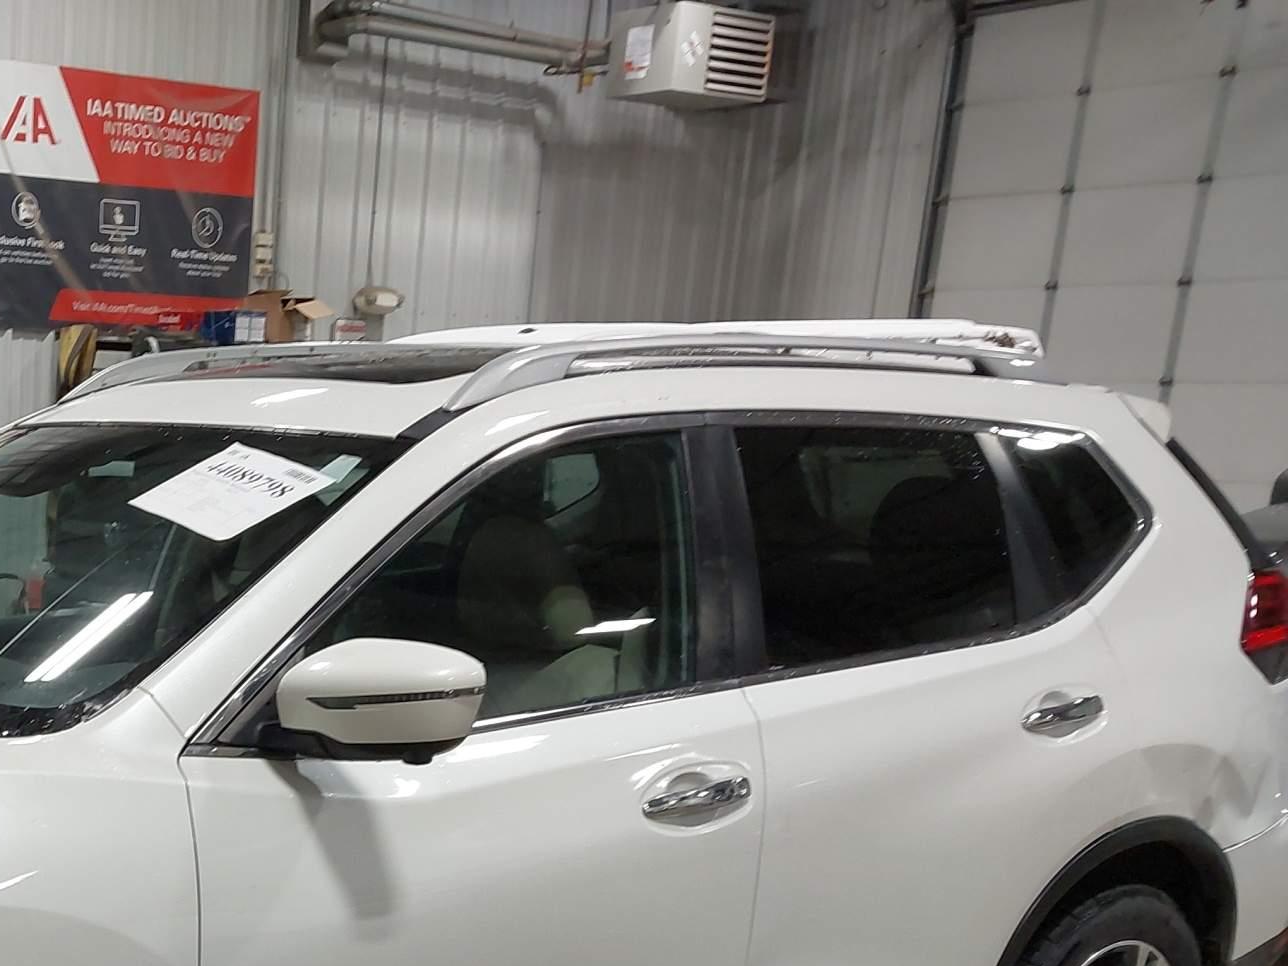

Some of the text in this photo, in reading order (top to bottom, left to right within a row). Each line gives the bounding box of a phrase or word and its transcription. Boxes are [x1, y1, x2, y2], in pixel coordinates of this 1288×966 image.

[87, 98, 112, 117] IAA
[115, 102, 165, 123] TIMED
[103, 120, 236, 149] INTRODUCING A NEW
[110, 139, 226, 163] WAY TO BID & BUY
[90, 242, 147, 257] Quick and Easy
[171, 248, 208, 260] Real-Time
[207, 461, 296, 498] 44089798
